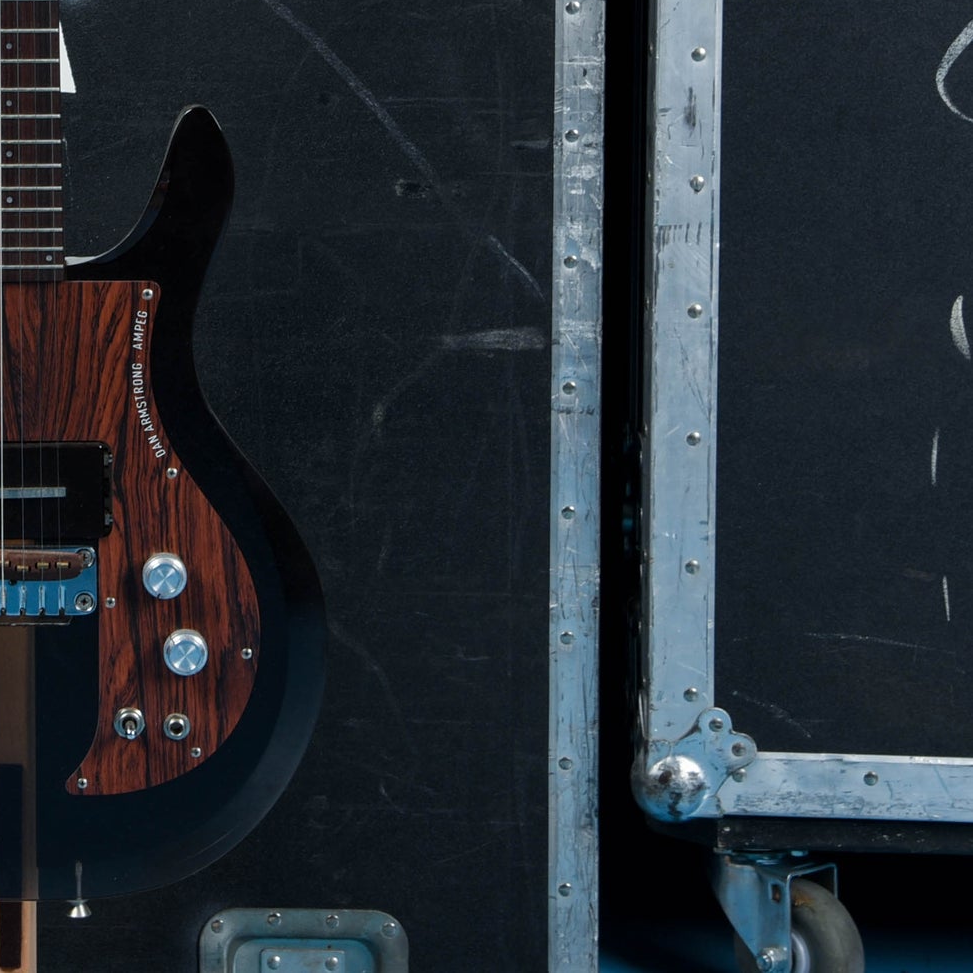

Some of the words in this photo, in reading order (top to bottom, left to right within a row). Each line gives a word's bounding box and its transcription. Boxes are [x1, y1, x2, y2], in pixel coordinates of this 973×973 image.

[132, 310, 148, 350] AMPEG
[132, 363, 155, 432] ARMSTRONG
[147, 434, 166, 458] DAN
